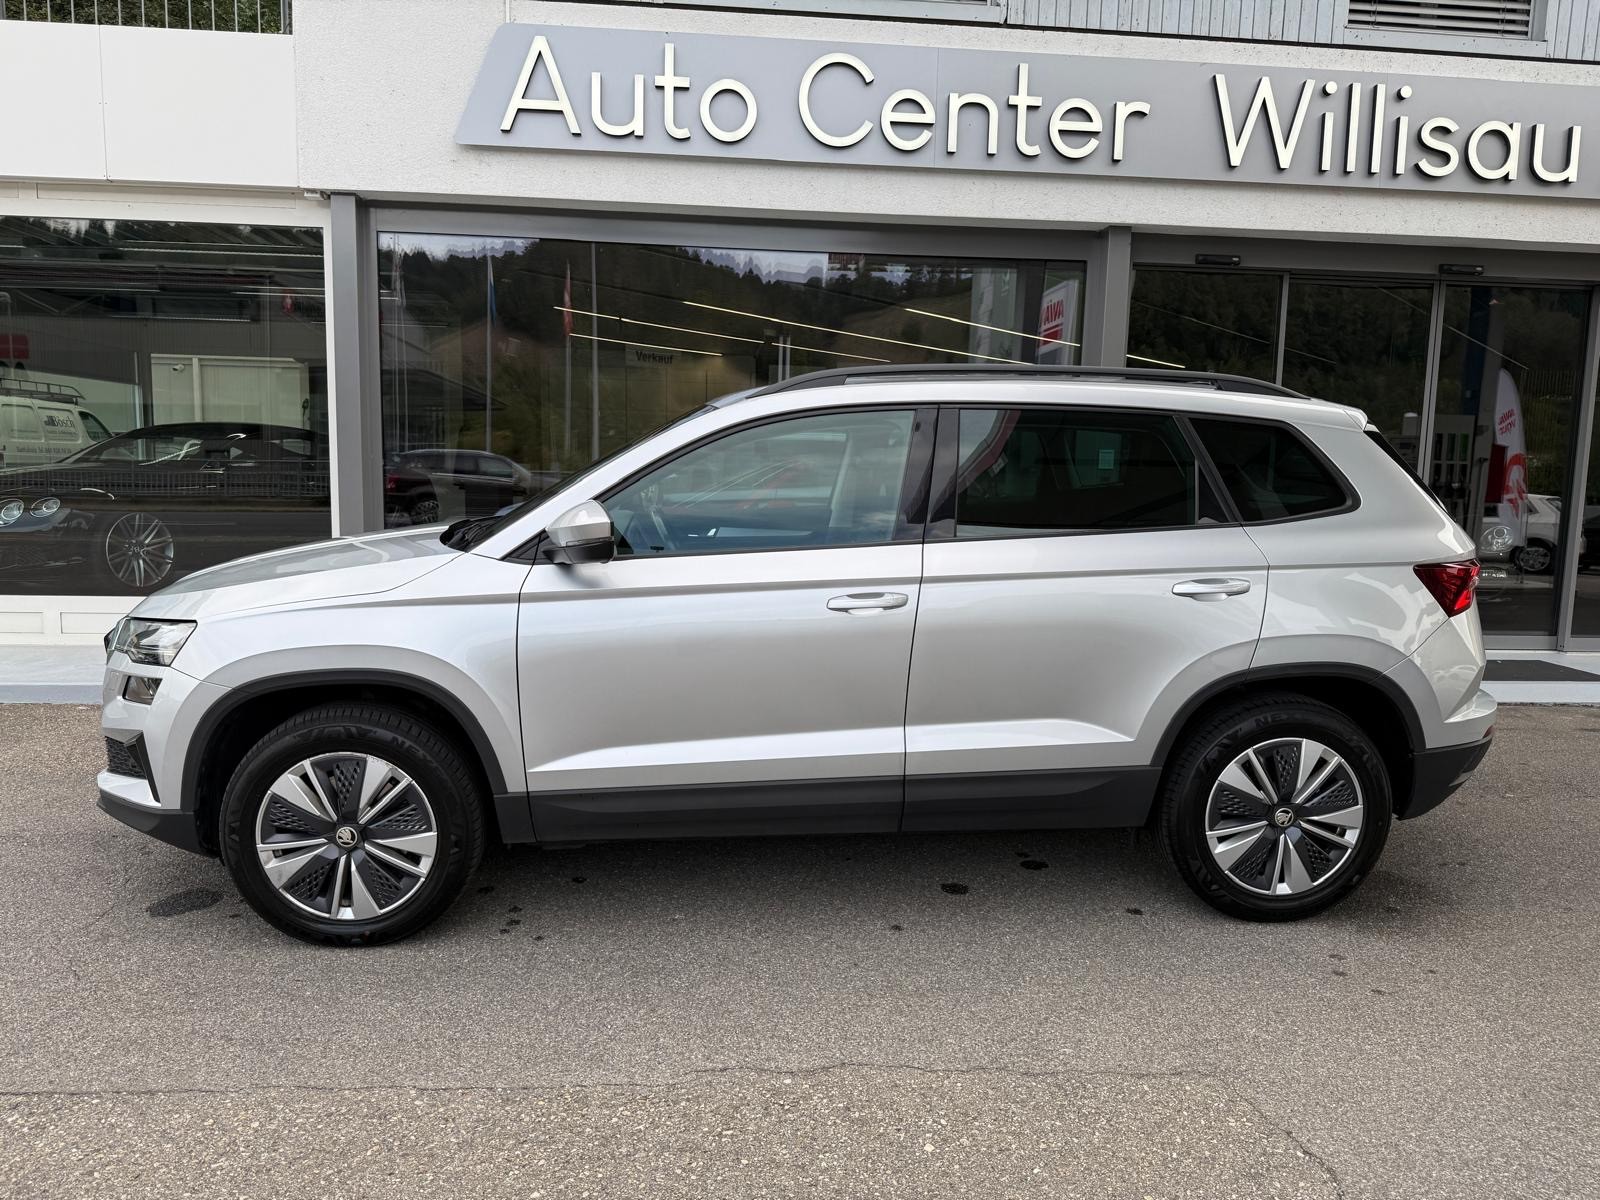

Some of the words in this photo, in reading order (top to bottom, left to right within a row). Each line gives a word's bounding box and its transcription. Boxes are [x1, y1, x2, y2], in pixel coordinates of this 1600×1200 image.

[500, 36, 758, 142] Auto
[798, 52, 1151, 161] Center
[1214, 73, 1582, 183] Willisau
[635, 350, 673, 364] Verkauf
